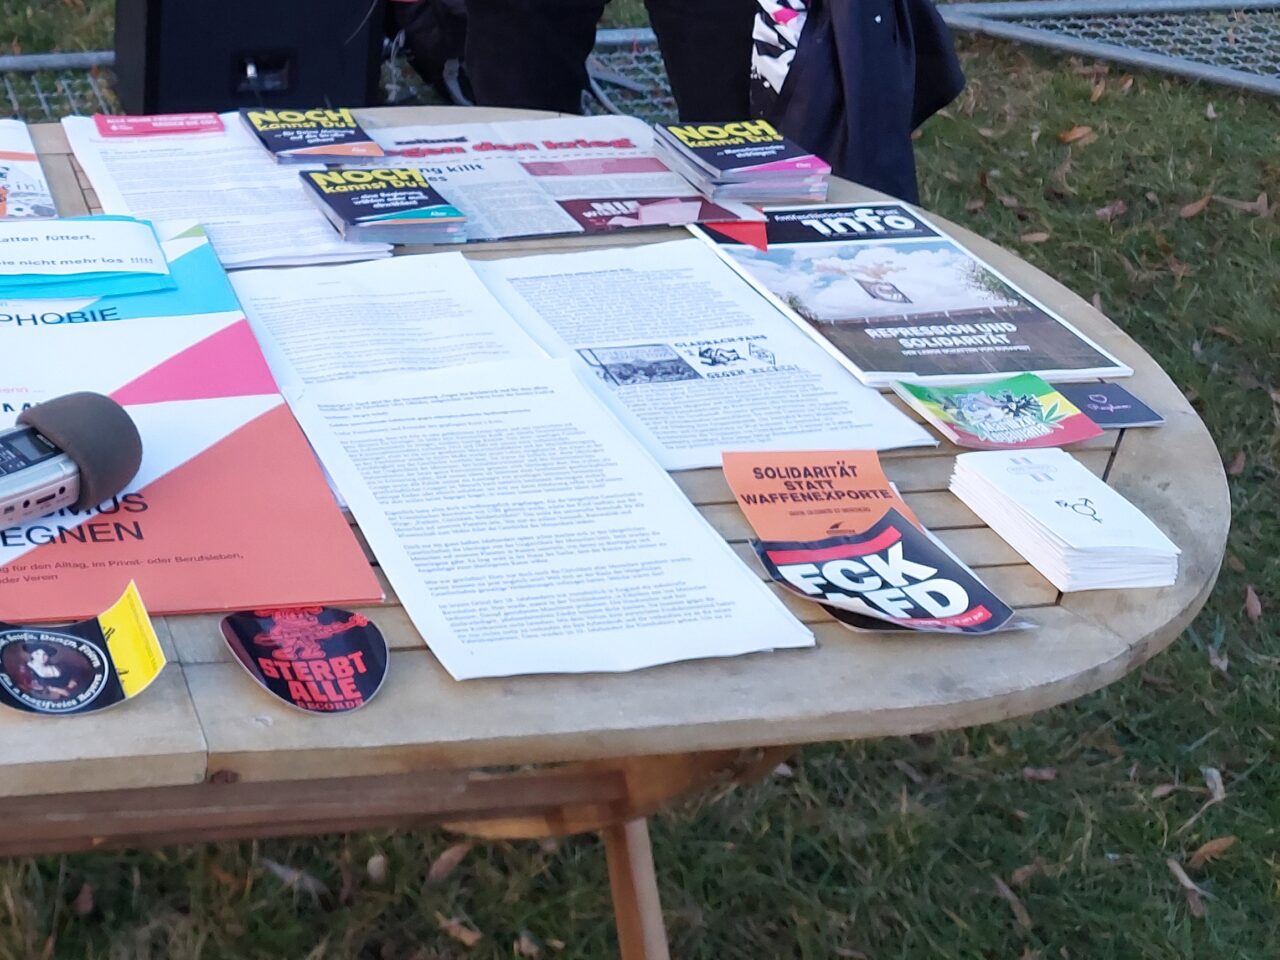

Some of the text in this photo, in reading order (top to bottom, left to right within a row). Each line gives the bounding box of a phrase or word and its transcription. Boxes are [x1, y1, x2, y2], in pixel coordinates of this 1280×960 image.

[247, 108, 354, 127] NOCH
[255, 121, 318, 132] kannst
[668, 120, 779, 141] NOCH
[472, 141, 540, 152] den
[685, 136, 745, 148] kannst
[308, 167, 426, 187] NOCH
[445, 163, 485, 173] killt
[320, 181, 388, 194] kannst
[19, 258, 57, 266] nicht
[60, 257, 98, 265] mehr
[864, 322, 1018, 339] REPRESSION UND
[899, 331, 1012, 349] SOLIDARITÄT
[752, 460, 858, 480] SOLIDARITÄT
[783, 480, 835, 491] STATT
[741, 488, 893, 507] WAFFENEXPORTE
[11, 563, 27, 573] für
[30, 562, 52, 570] den
[53, 560, 90, 570] Alltag,
[91, 560, 107, 568] im
[107, 558, 145, 567] Privat-
[147, 556, 172, 564] oder
[174, 551, 245, 563] Berufsleben,
[777, 540, 939, 595] FCK
[23, 573, 59, 582] Verein
[257, 650, 368, 682] STERBT
[287, 677, 363, 702] ALLE
